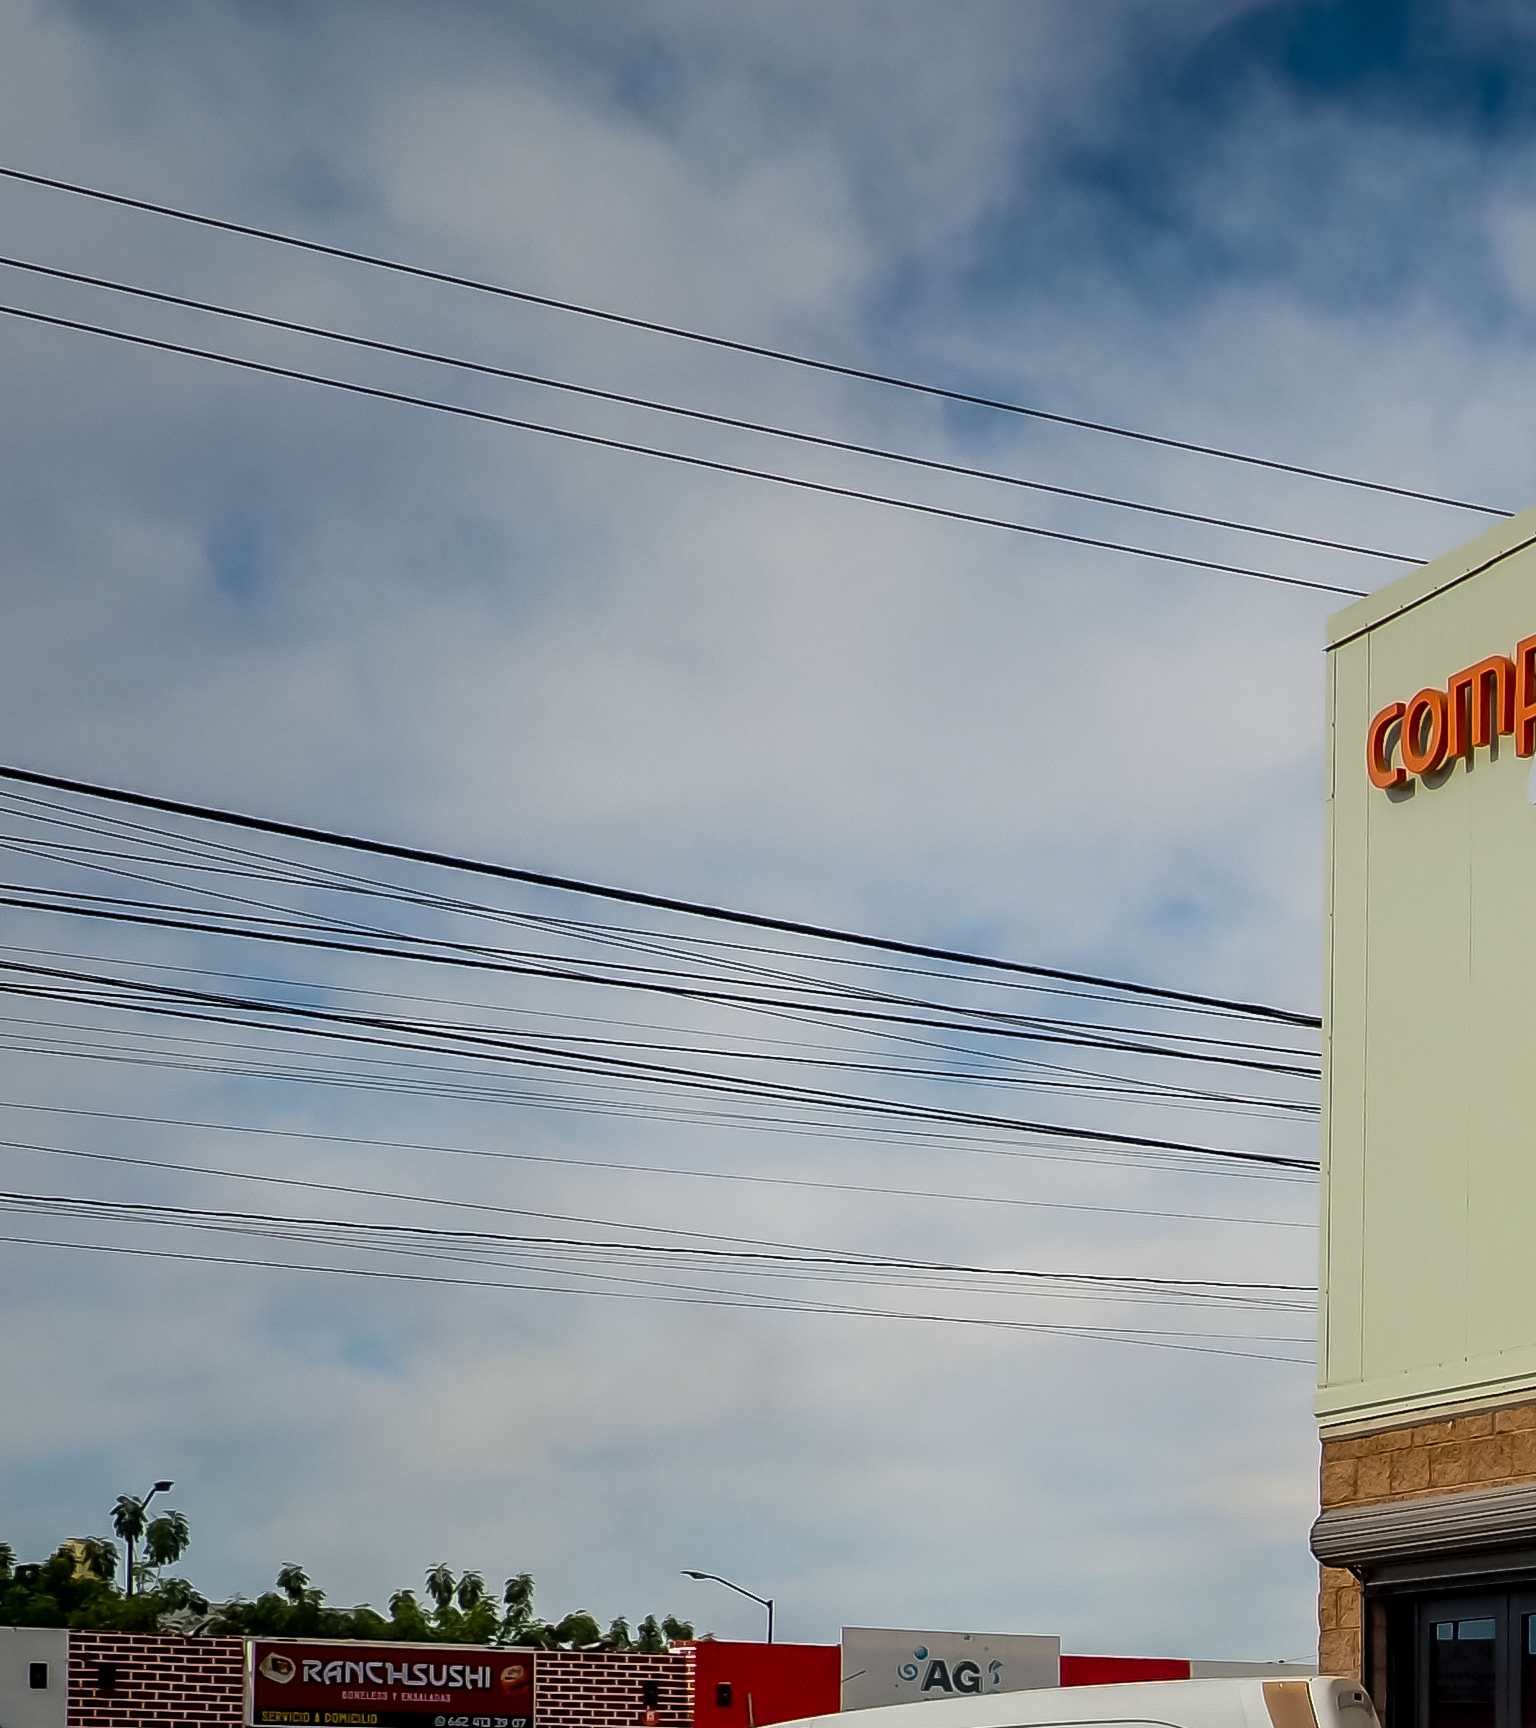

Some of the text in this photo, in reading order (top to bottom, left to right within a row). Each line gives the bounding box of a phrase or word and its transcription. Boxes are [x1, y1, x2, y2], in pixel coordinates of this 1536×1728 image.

[921, 1659, 983, 1693] AG
[262, 1711, 378, 1724] SERVICIO A DOMICILIO
